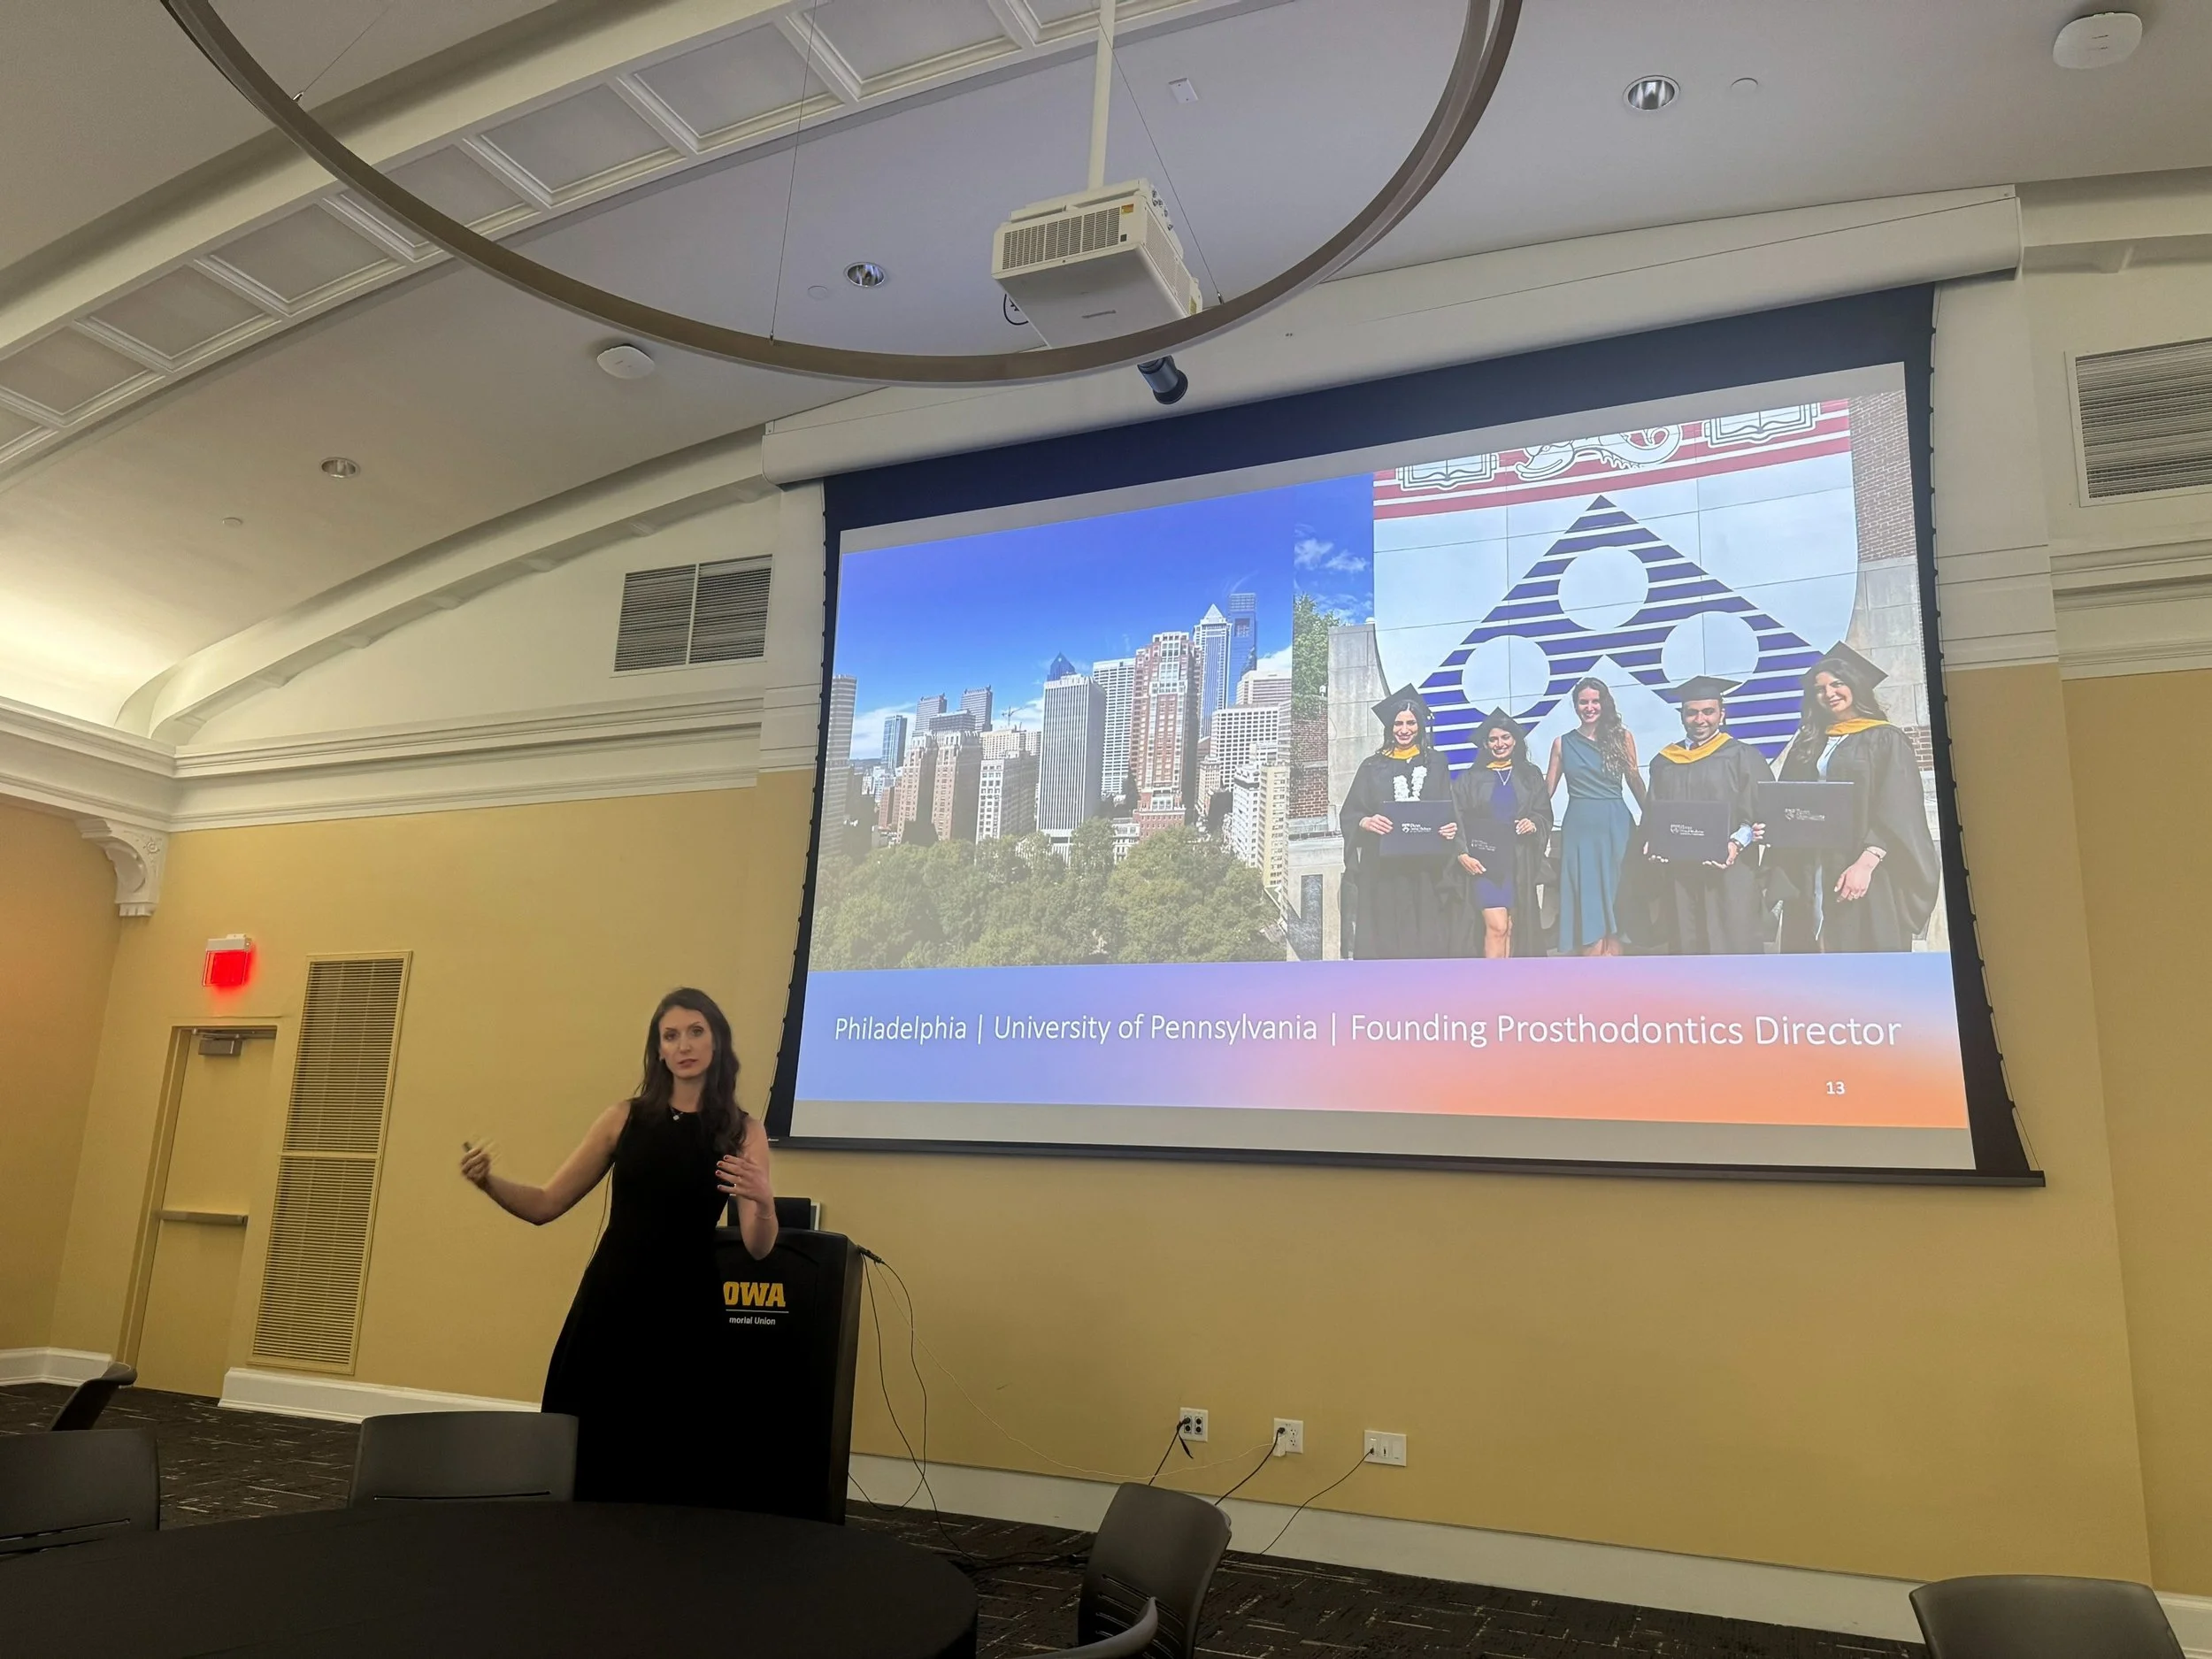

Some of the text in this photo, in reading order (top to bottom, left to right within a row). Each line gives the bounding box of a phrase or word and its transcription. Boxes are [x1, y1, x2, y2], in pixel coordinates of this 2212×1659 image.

[835, 1015, 967, 1046] Philadelphia
[995, 1015, 1111, 1045] University
[1118, 1013, 1144, 1040] of
[1151, 1012, 1317, 1046] Pennsylvania
[1352, 1012, 1487, 1048] Founding
[1498, 1013, 1744, 1045] Prosthodontics
[1755, 1015, 1902, 1046] Director
[1825, 1080, 1847, 1096] 13
[723, 1281, 786, 1307] OWA
[729, 1316, 776, 1325] morial Union
